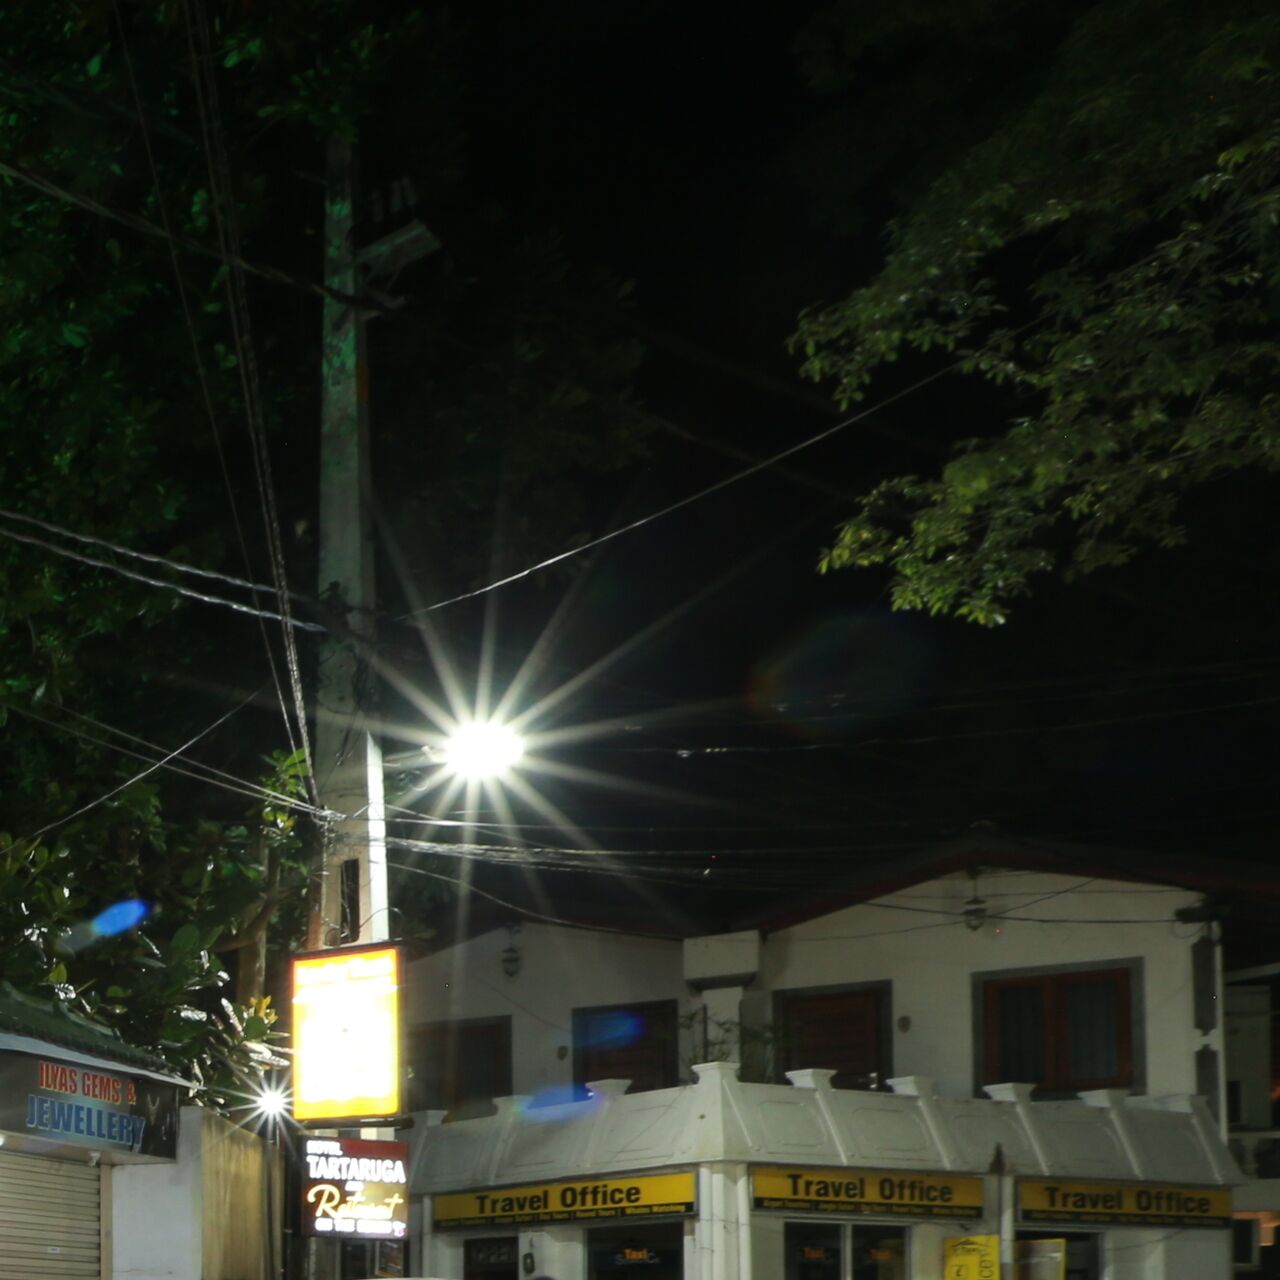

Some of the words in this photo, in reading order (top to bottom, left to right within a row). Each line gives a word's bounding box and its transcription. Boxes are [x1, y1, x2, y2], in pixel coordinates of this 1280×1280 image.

[39, 1061, 78, 1095] ILYAS
[82, 1071, 122, 1105] GEMS
[125, 1079, 137, 1105] &
[26, 1094, 146, 1149] JEWELLERY
[306, 1155, 406, 1183] TARTARUGA
[476, 1190, 549, 1214] Travel
[560, 1184, 641, 1208] Office
[787, 1174, 865, 1199] Travel
[879, 1178, 953, 1202] Office
[1044, 1187, 1124, 1210] Travel
[1136, 1190, 1211, 1213] Office
